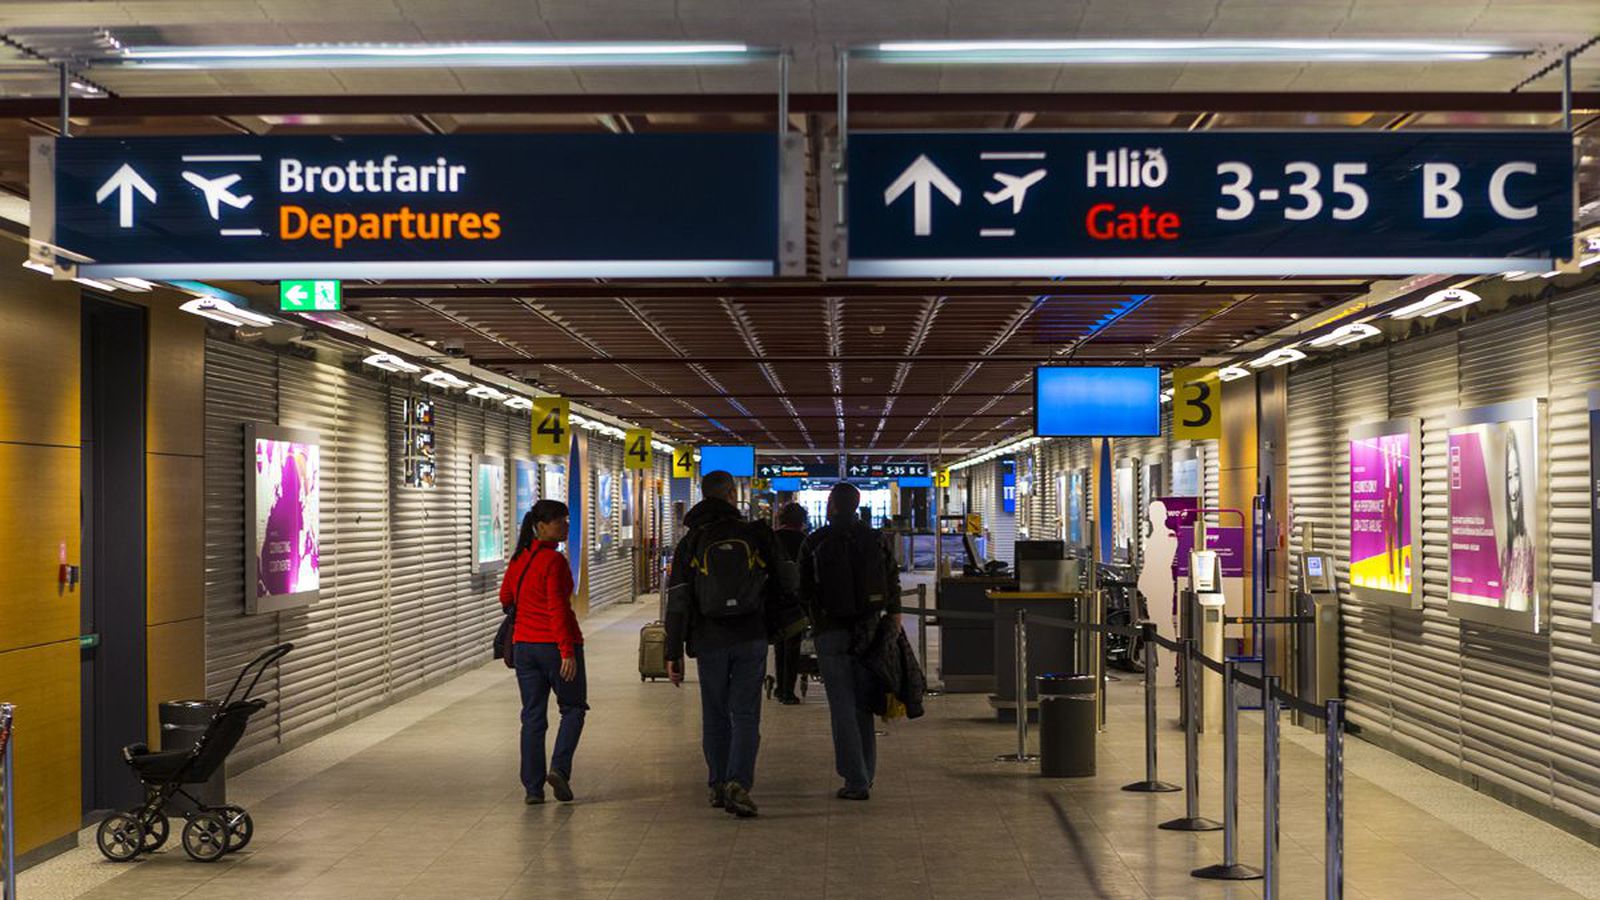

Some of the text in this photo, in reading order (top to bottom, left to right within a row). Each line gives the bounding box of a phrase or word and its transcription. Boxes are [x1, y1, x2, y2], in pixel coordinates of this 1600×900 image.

[279, 154, 467, 194] Brottfarir
[1086, 147, 1168, 189] Hlið
[1216, 161, 1538, 221] 3-35 B C
[279, 205, 501, 249] Departures
[1085, 203, 1181, 240] Gate
[1182, 381, 1212, 428] 3
[536, 407, 565, 445] 4
[628, 435, 649, 463] 4
[677, 451, 693, 472] 4
